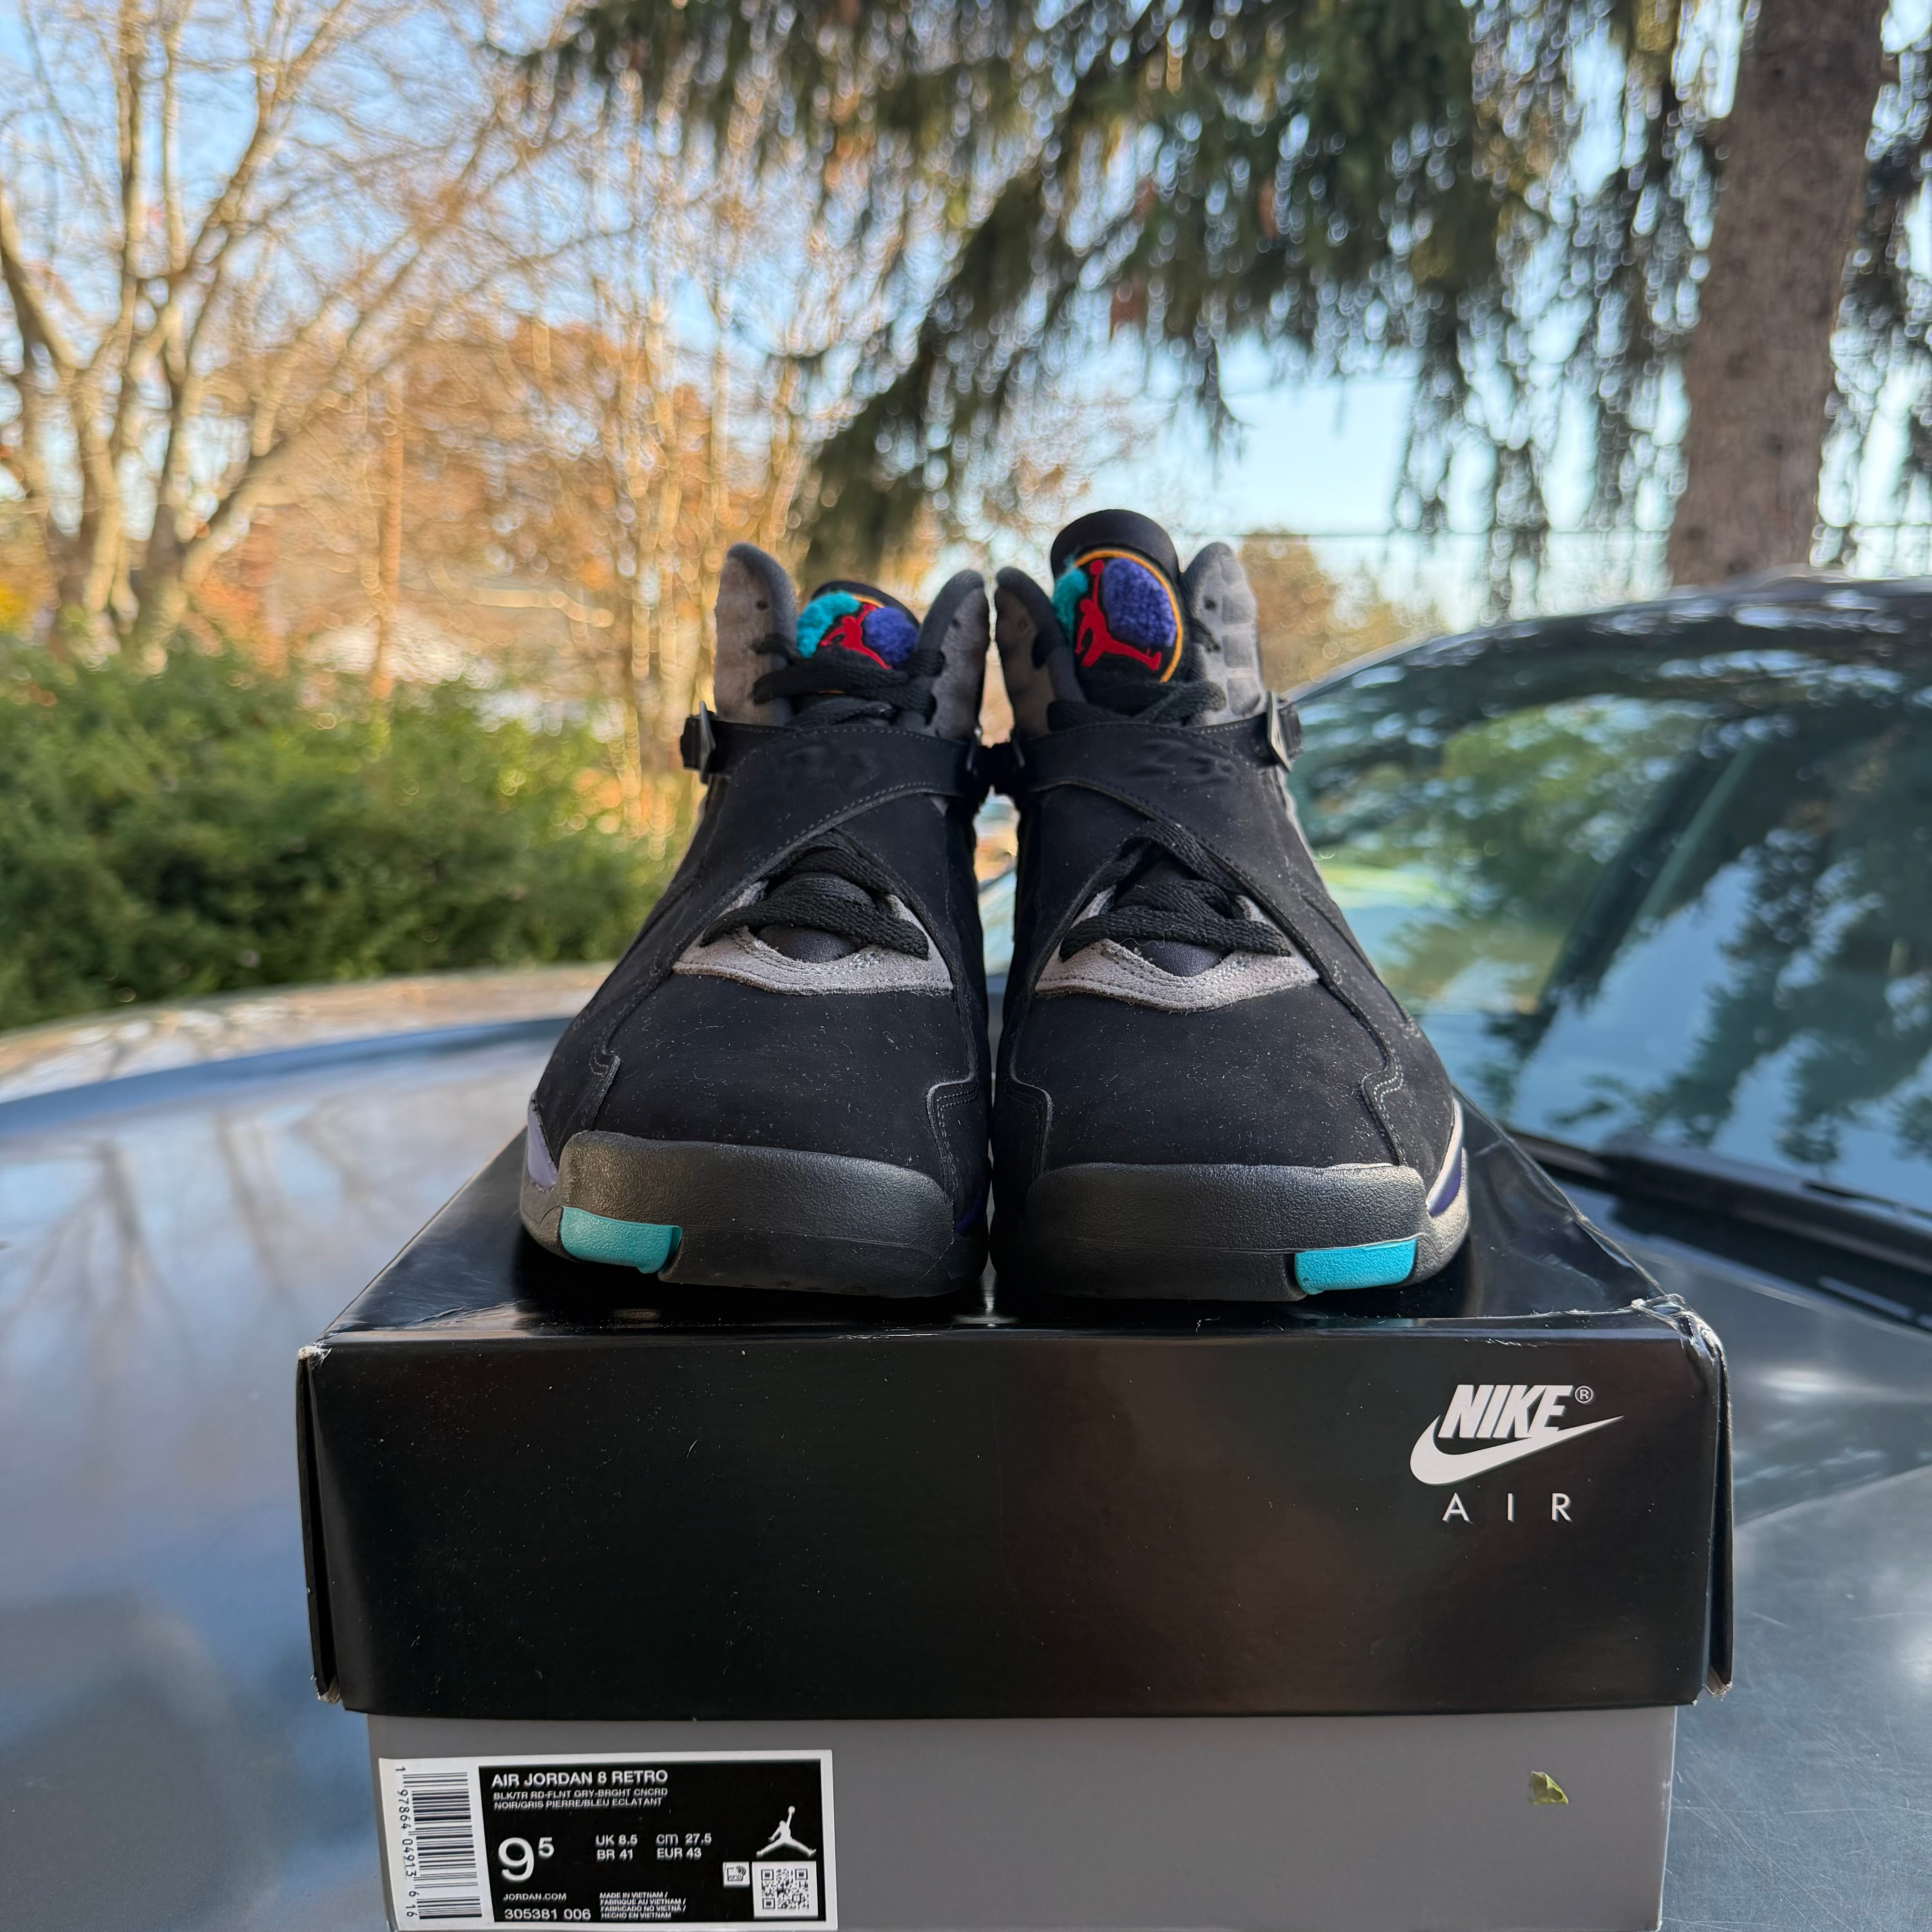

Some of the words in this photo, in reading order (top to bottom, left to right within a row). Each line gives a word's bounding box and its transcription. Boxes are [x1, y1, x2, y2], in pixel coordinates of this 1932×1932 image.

[1443, 1493, 1571, 1522] AIR
[492, 1773, 520, 1789] AIR
[524, 1771, 593, 1787] JORDAN
[598, 1771, 607, 1785] 8
[611, 1769, 668, 1785] RETRO
[493, 1791, 528, 1801] BLK/TR
[530, 1790, 571, 1800] RD-FLNT
[574, 1788, 631, 1799] GRY-BRGHT
[633, 1787, 668, 1797] CNCRD
[494, 1800, 544, 1810] NOIR/GRIS
[546, 1798, 610, 1809] PIERRE/BLEU
[612, 1797, 662, 1808] ECLATANT
[595, 1834, 615, 1847] UK
[597, 1849, 615, 1861] BR
[619, 1849, 633, 1860] 41
[657, 1848, 683, 1861] EUR
[685, 1847, 702, 1859] 43
[503, 1892, 567, 1902] JORDAN.COM
[504, 1908, 557, 1920] 305381
[564, 1908, 591, 1920] 006
